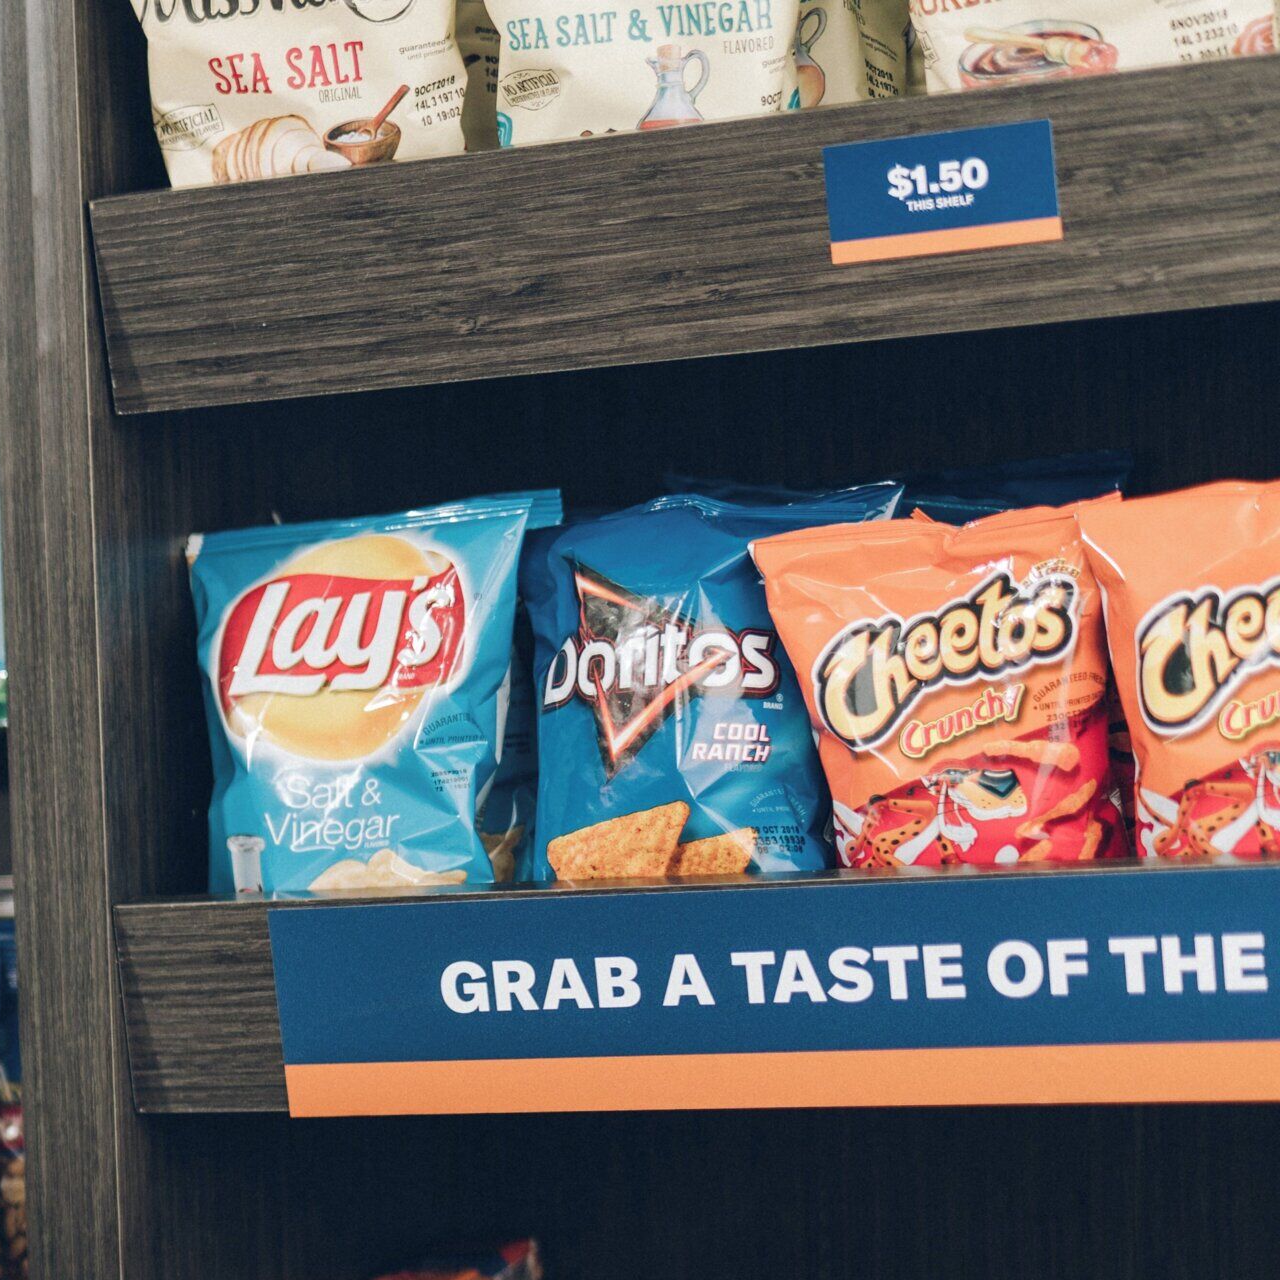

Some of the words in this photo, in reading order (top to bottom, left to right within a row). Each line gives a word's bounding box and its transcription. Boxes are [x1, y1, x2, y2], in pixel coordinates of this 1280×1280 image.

[507, 17, 548, 50] SEA
[556, 11, 616, 47] SALT
[628, 9, 652, 42] &
[657, 0, 773, 37] VINEGAR
[723, 36, 774, 54] FLAVORED
[208, 53, 272, 95] SEA
[285, 41, 363, 90] SALT
[318, 87, 362, 104] ORIGINAL
[503, 82, 517, 98] NO
[887, 157, 989, 199] $1.50
[906, 199, 934, 212] THIS
[935, 194, 974, 210] SHELF
[228, 574, 456, 697] Lay's
[543, 618, 778, 706] Doritos
[819, 573, 1077, 741] Cheetos
[713, 723, 769, 741] COOL
[901, 685, 1024, 757] Crunchy
[1220, 695, 1280, 737] Cru
[692, 743, 770, 762] RANCH
[286, 775, 354, 809] Salt
[361, 778, 381, 806] &
[265, 813, 400, 850] Vinegar
[441, 956, 639, 1014] GRAB
[663, 953, 715, 1007] A
[731, 943, 966, 1003] TASTE
[987, 939, 1089, 997] OF
[1109, 932, 1268, 993] THE
